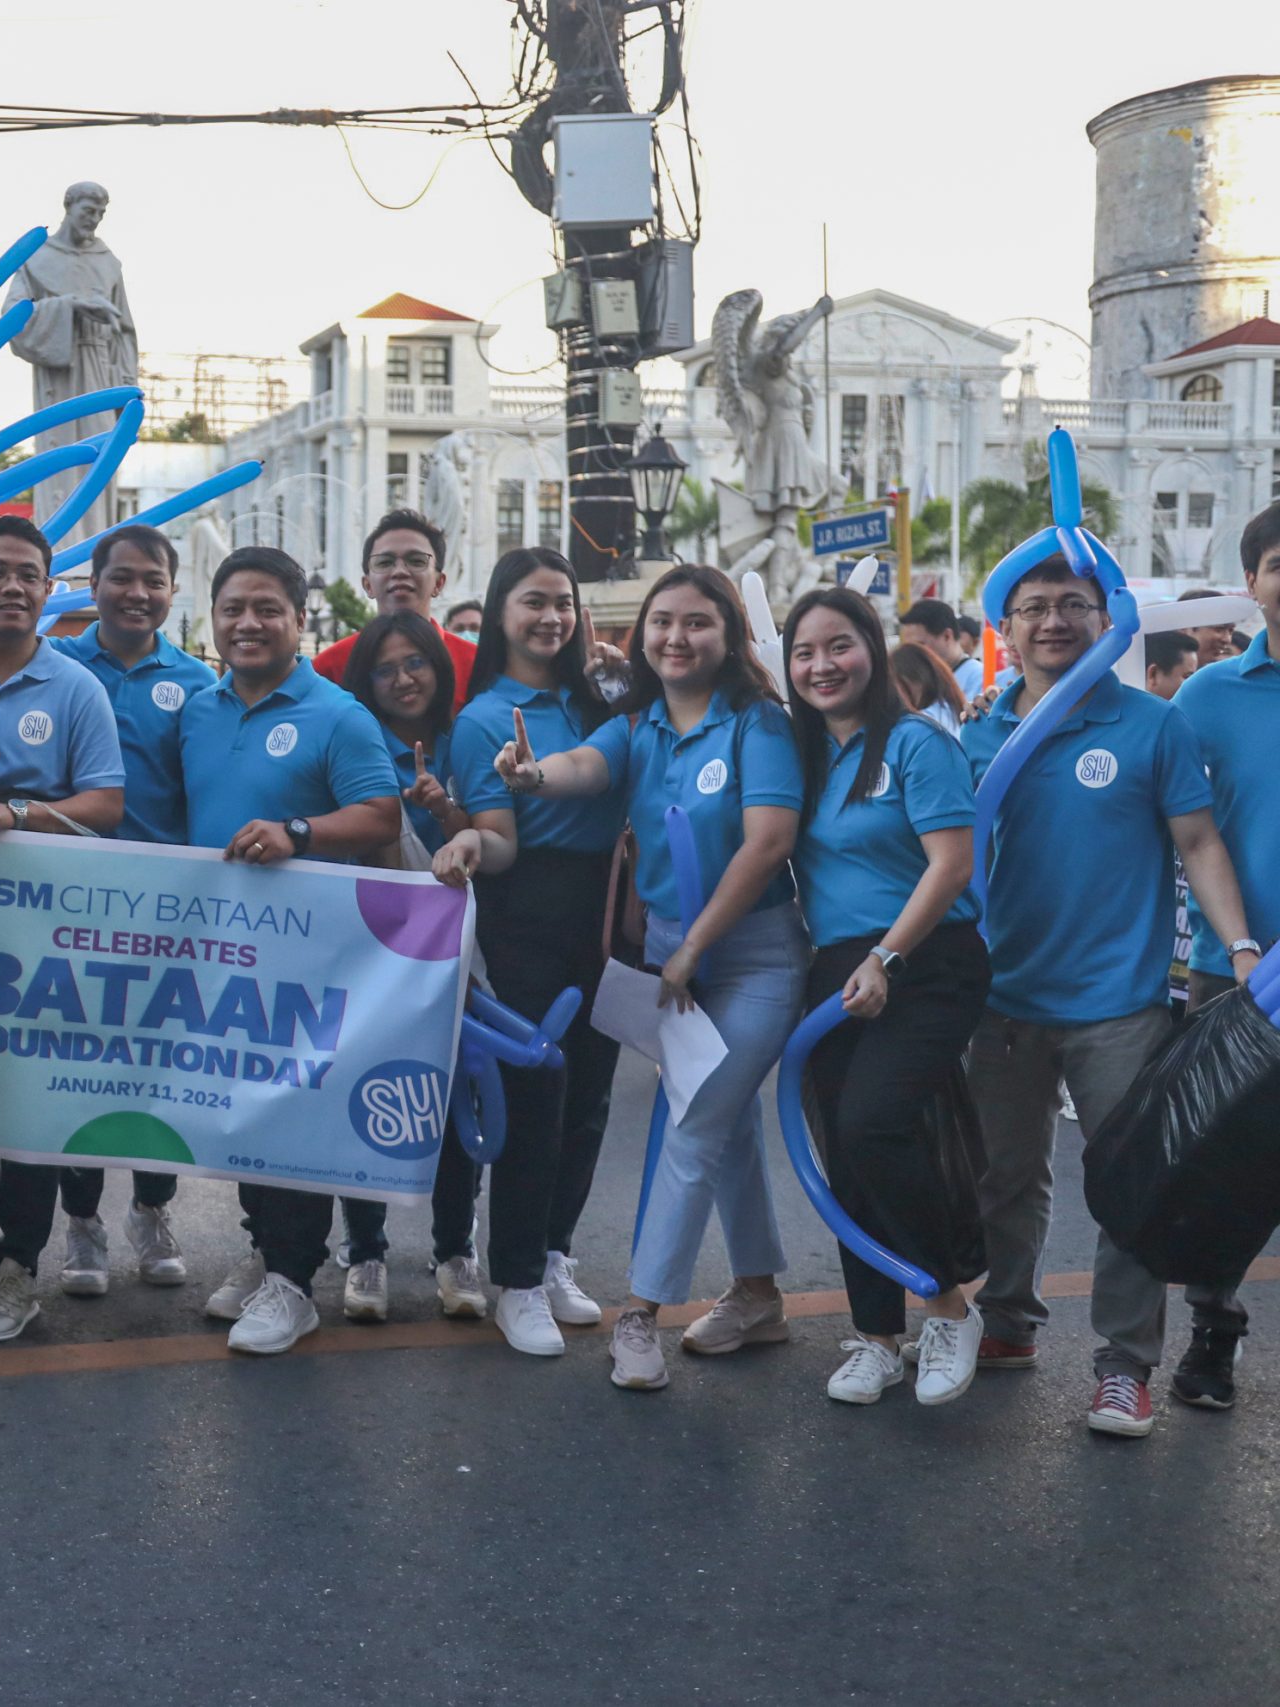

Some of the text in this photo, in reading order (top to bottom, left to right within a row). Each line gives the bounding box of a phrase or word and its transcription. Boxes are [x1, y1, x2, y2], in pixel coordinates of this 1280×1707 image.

[835, 523, 866, 544] RIZAL
[867, 519, 884, 538] ST.
[21, 714, 48, 740] SM
[1080, 754, 1111, 782] SM
[59, 885, 146, 919] CITY
[155, 893, 312, 938] BATAAN
[51, 925, 258, 967] CELEBRATES
[242, 1048, 335, 1091] DAY
[46, 1076, 233, 1111] JANUARY 11, 2024
[361, 1071, 444, 1147] SM
